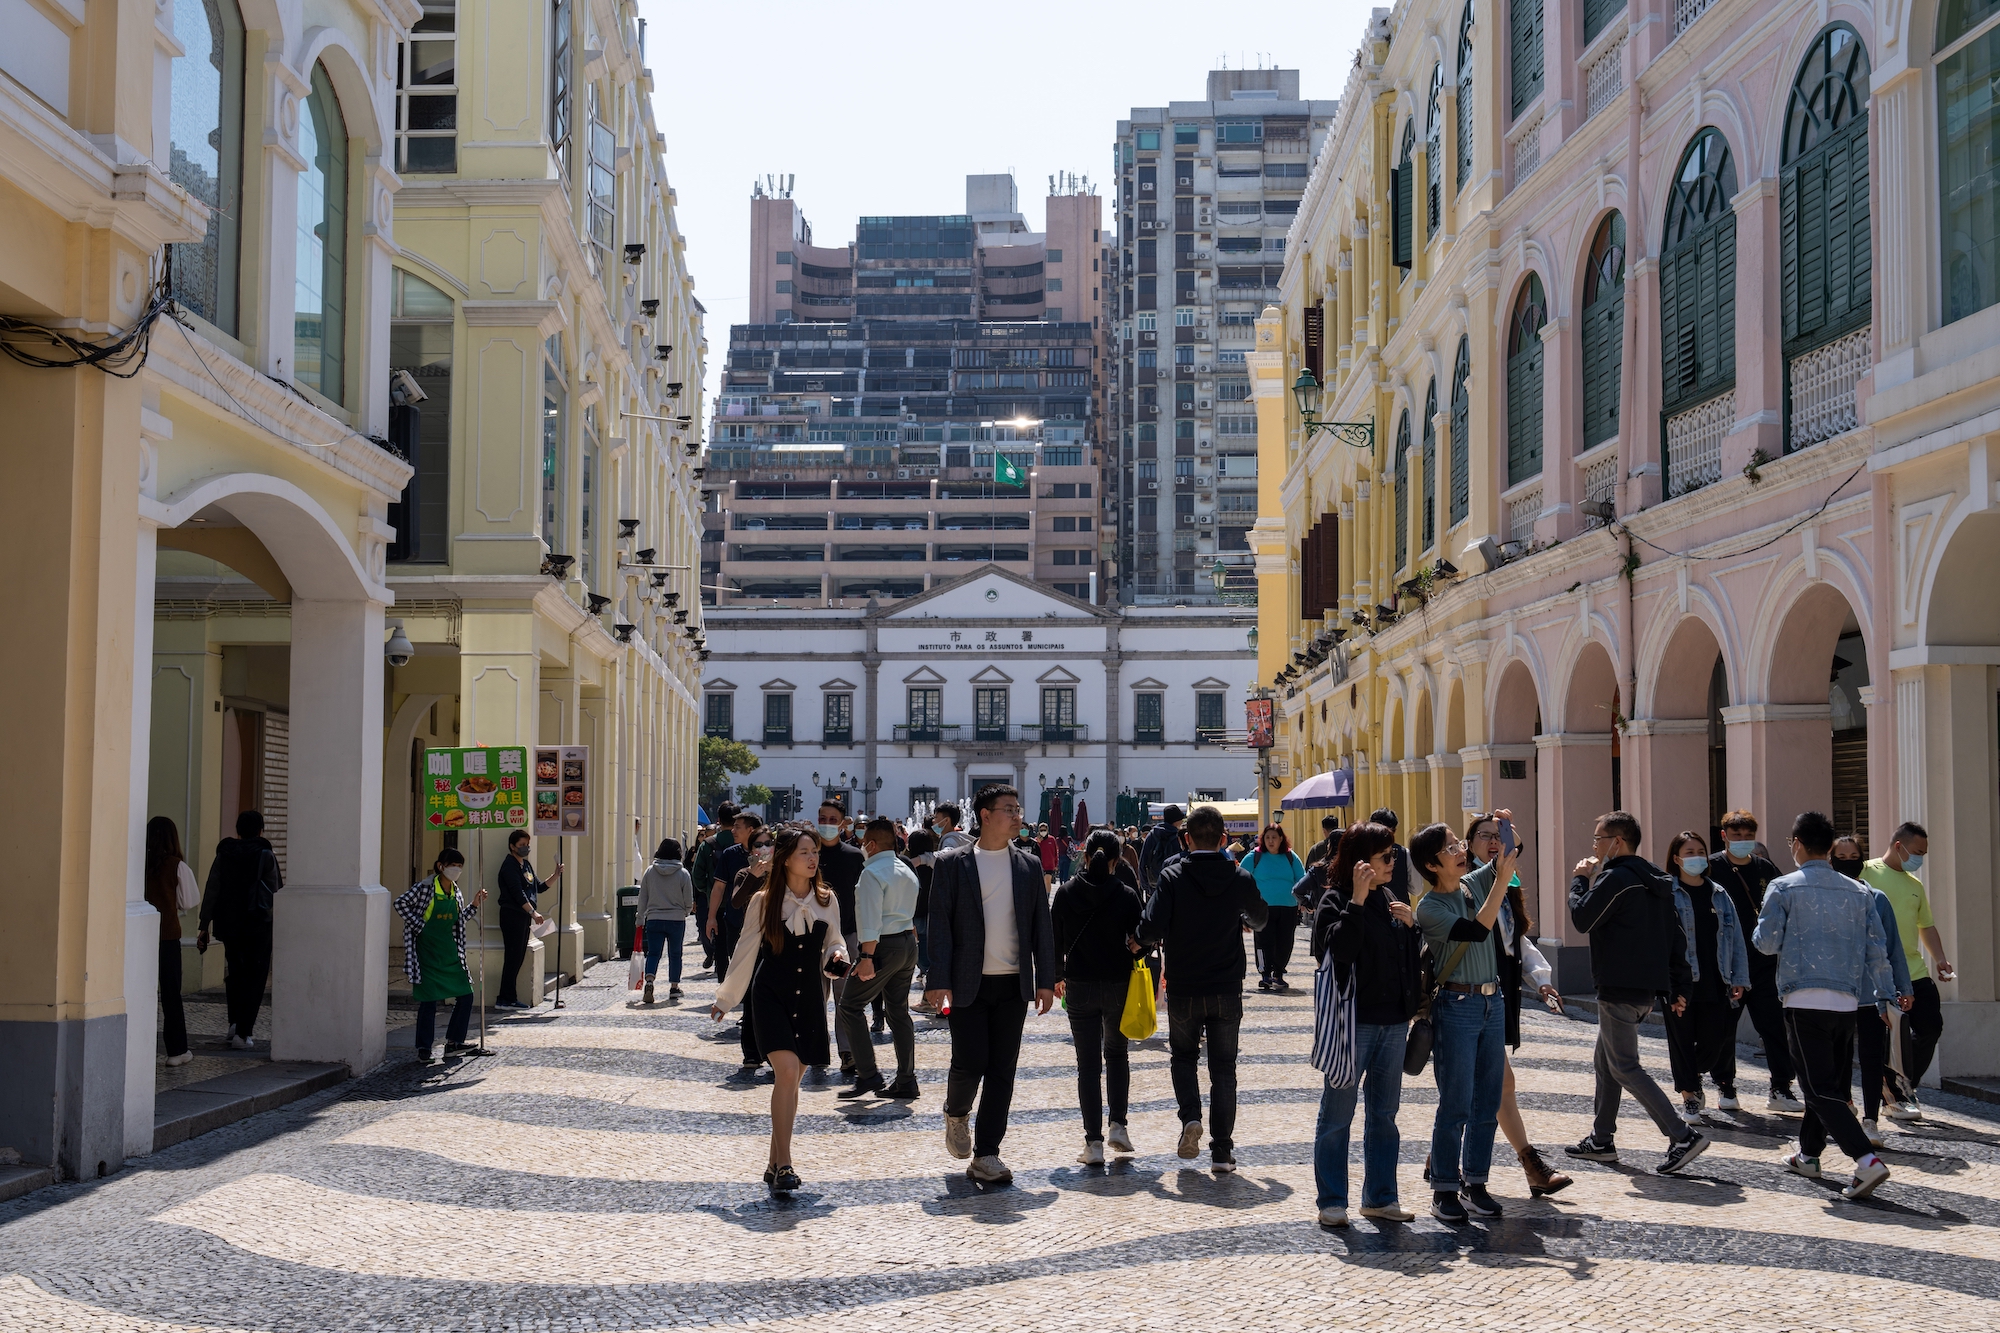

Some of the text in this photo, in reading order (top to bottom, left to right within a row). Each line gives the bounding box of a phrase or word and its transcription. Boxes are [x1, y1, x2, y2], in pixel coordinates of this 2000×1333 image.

[950, 631, 1033, 642] 市政署
[427, 750, 522, 775] 咖喱榮
[429, 794, 458, 808] 牛雜
[468, 810, 505, 824] 豬扒包
